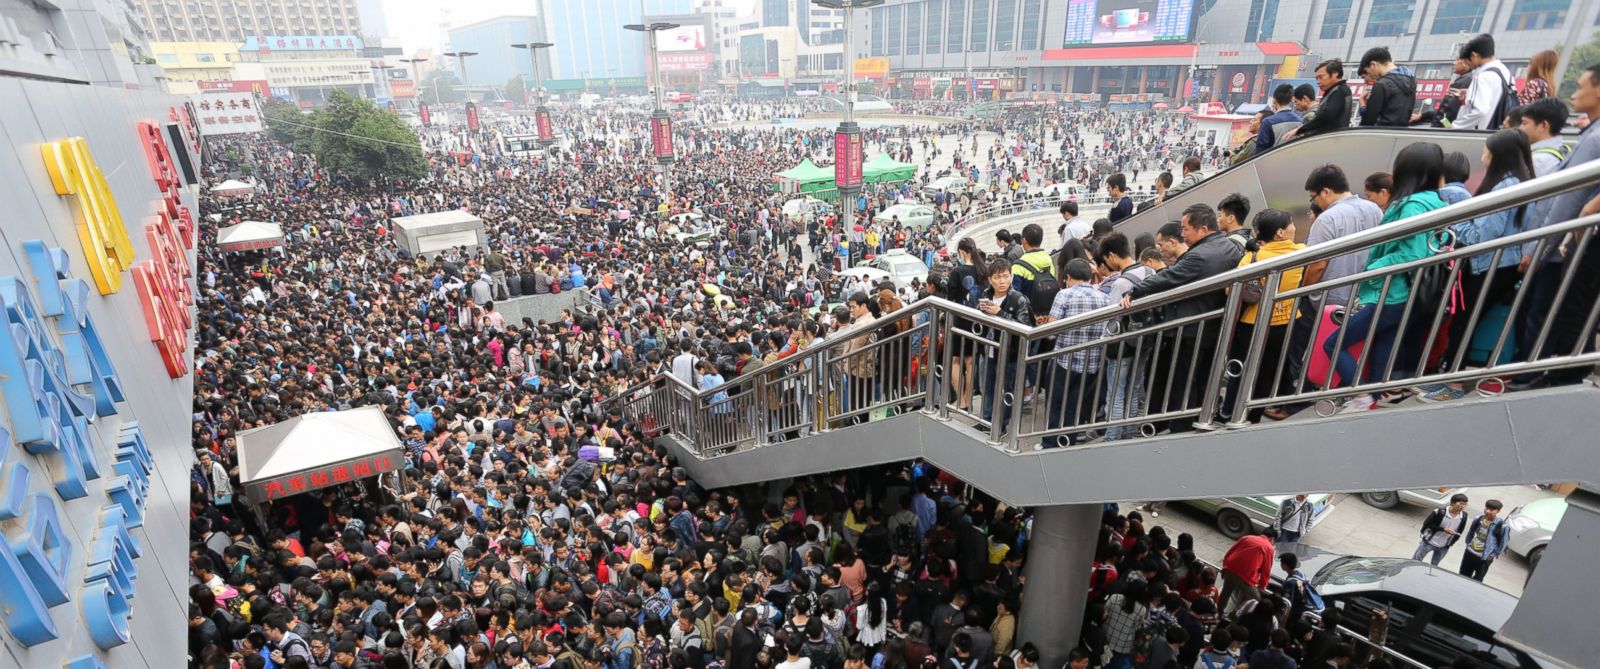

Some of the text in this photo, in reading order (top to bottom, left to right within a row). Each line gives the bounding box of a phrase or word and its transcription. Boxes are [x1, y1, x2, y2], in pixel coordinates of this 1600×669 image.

[264, 456, 391, 498] 汽车站进站口
